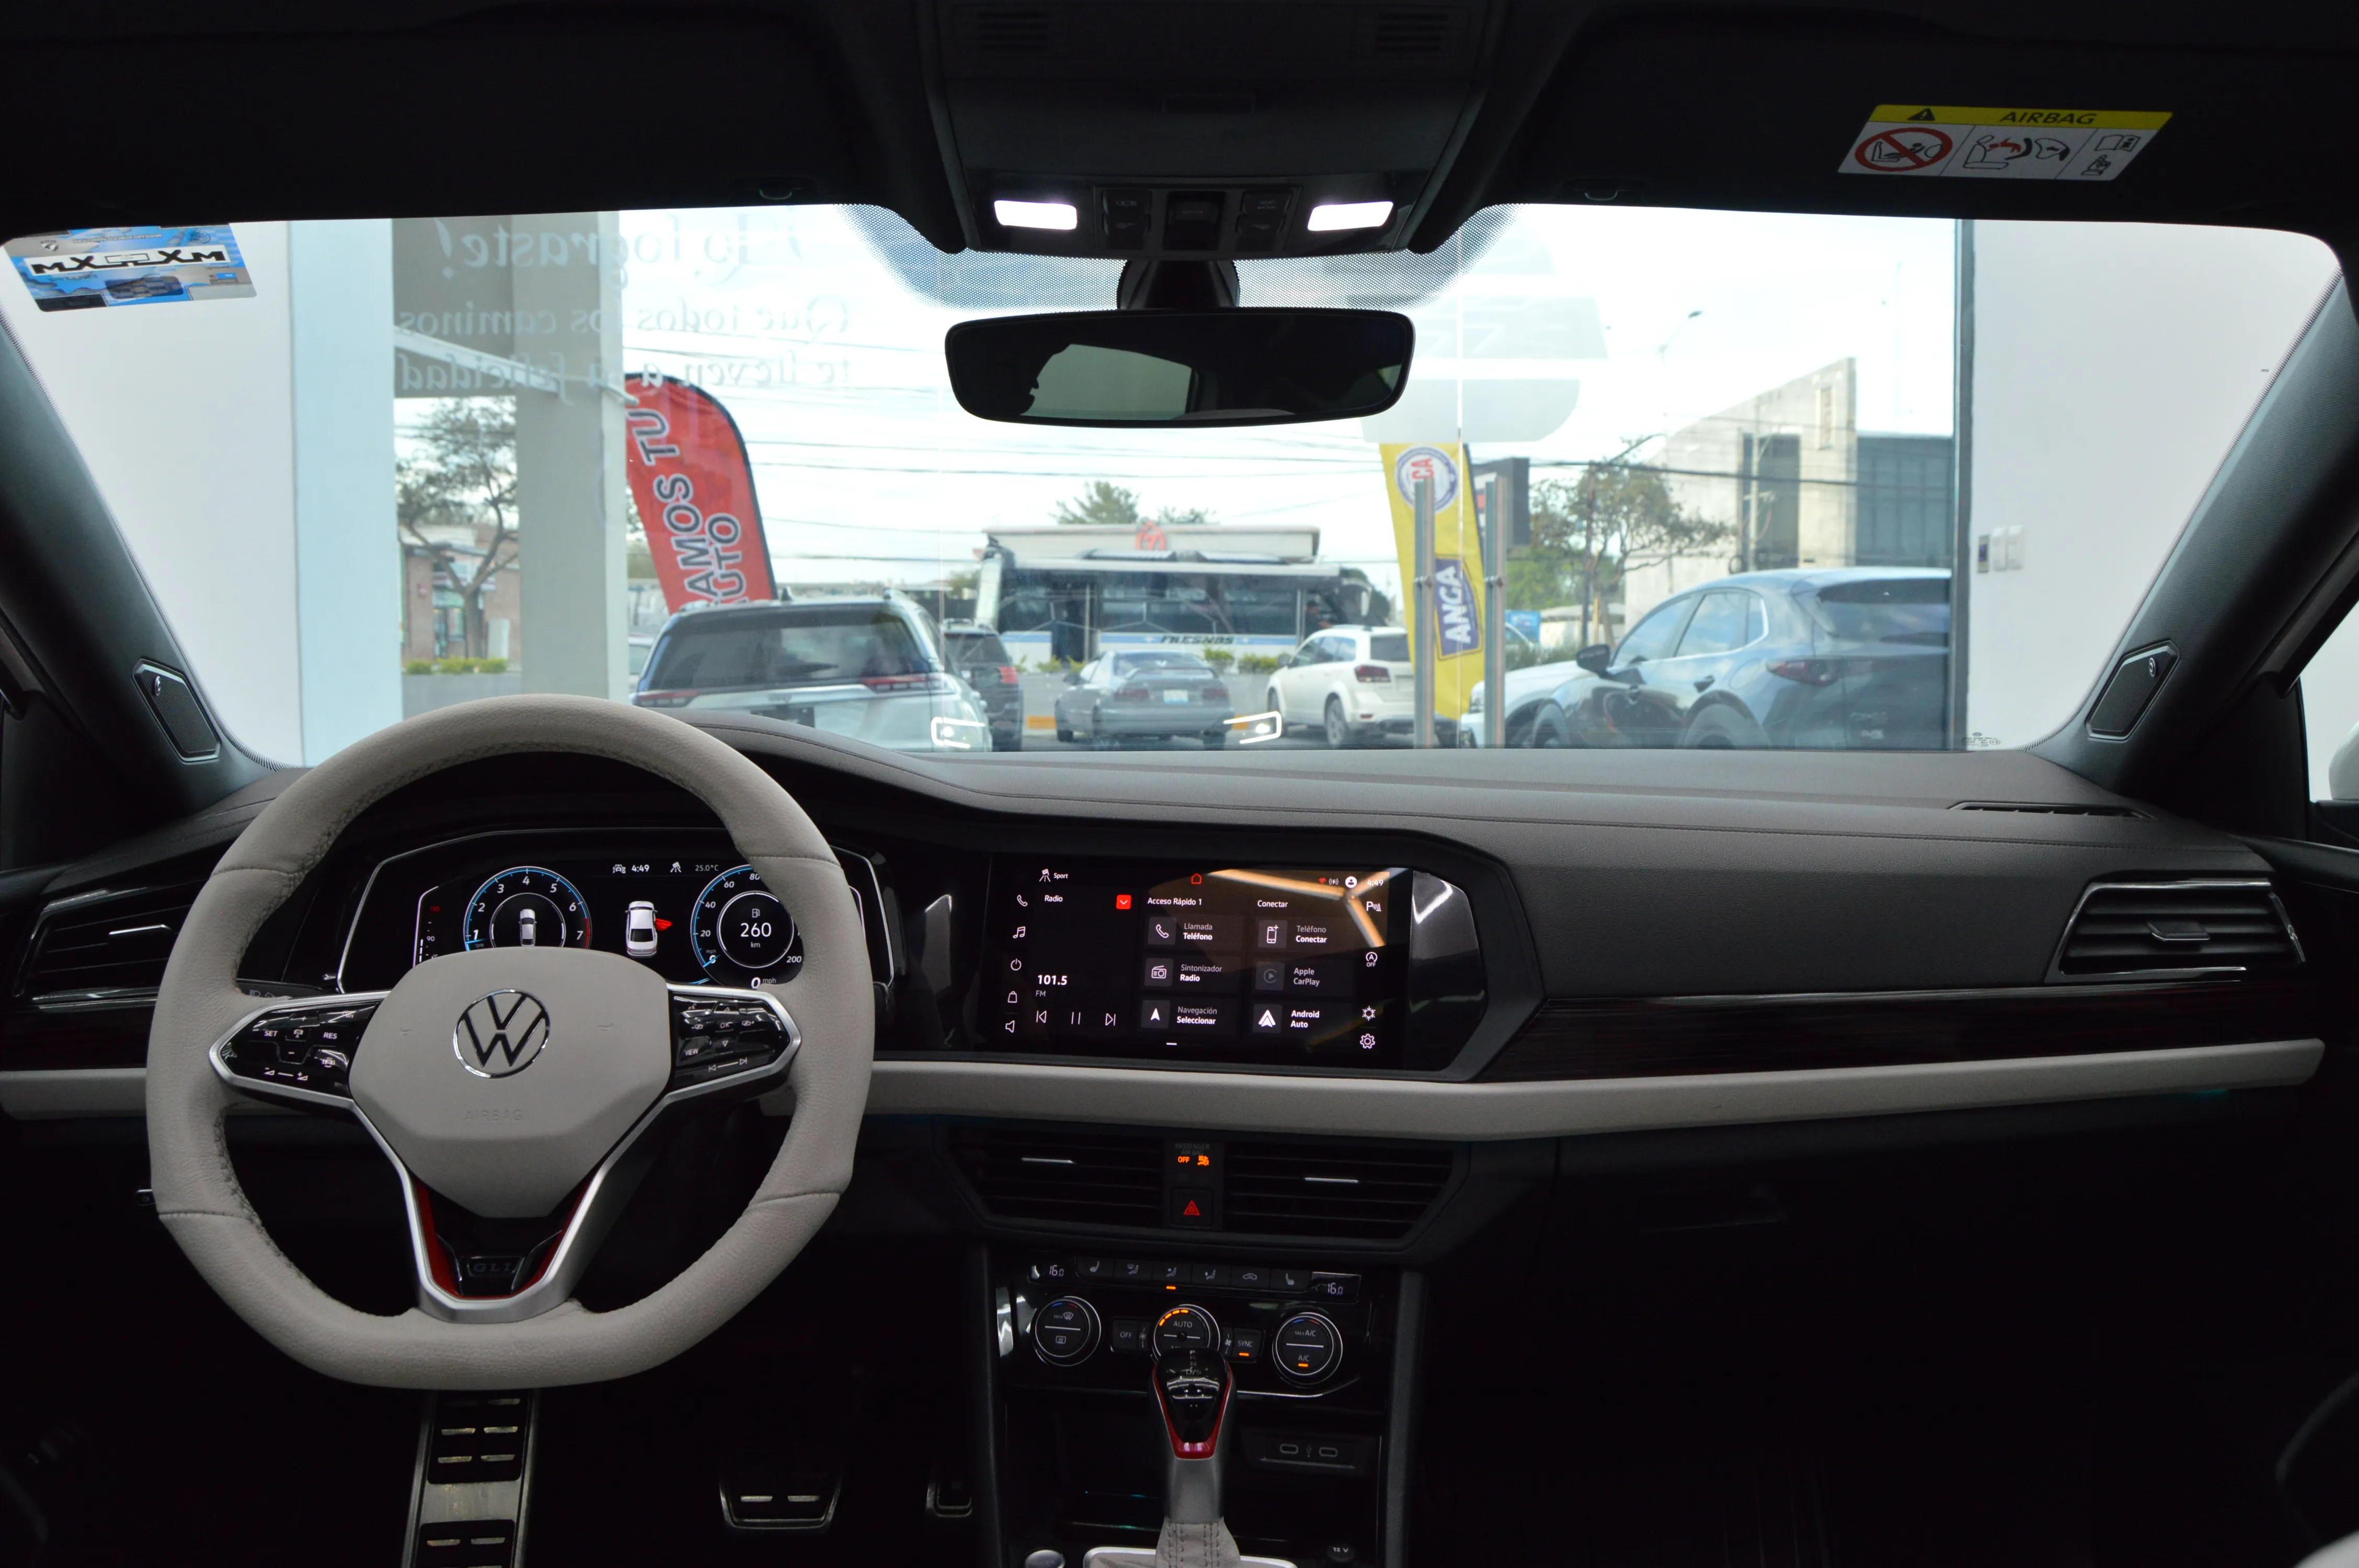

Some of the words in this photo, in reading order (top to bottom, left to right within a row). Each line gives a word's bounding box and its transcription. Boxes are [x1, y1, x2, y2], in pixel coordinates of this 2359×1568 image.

[2000, 111, 2098, 125] AIRBAG
[627, 409, 680, 466] TU
[654, 474, 719, 604] AMOS
[706, 512, 748, 606] UTO
[631, 864, 650, 872] 4:49
[523, 876, 530, 885] 4
[749, 873, 761, 881] 80
[497, 884, 505, 893] 3
[549, 883, 557, 893] 5
[705, 901, 716, 909] 40
[1173, 897, 1197, 906] Rápido
[478, 903, 486, 912] 2
[569, 902, 576, 912] 6
[700, 929, 711, 938] 20
[740, 922, 772, 938] 260
[1297, 925, 1327, 933] Teléfono
[473, 929, 479, 940] 1
[577, 930, 584, 940] 7
[1183, 933, 1213, 941] Teléfono
[1296, 935, 1327, 944] Conectar
[786, 955, 802, 964] 200
[1181, 965, 1223, 973] Sintonizador
[1293, 968, 1315, 976] Apple
[751, 977, 761, 989] 0
[1037, 974, 1068, 986] 101.5
[1180, 974, 1201, 983] Radio
[1293, 977, 1320, 987] CarPlay
[1177, 1006, 1218, 1016] Navegación
[1291, 1009, 1320, 1019] Android
[1176, 1016, 1216, 1025] Seleccionar
[1290, 1020, 1309, 1029] Auto
[684, 1047, 699, 1056] VIEW
[473, 1263, 511, 1272] GLI
[1305, 1329, 1317, 1338] A/C
